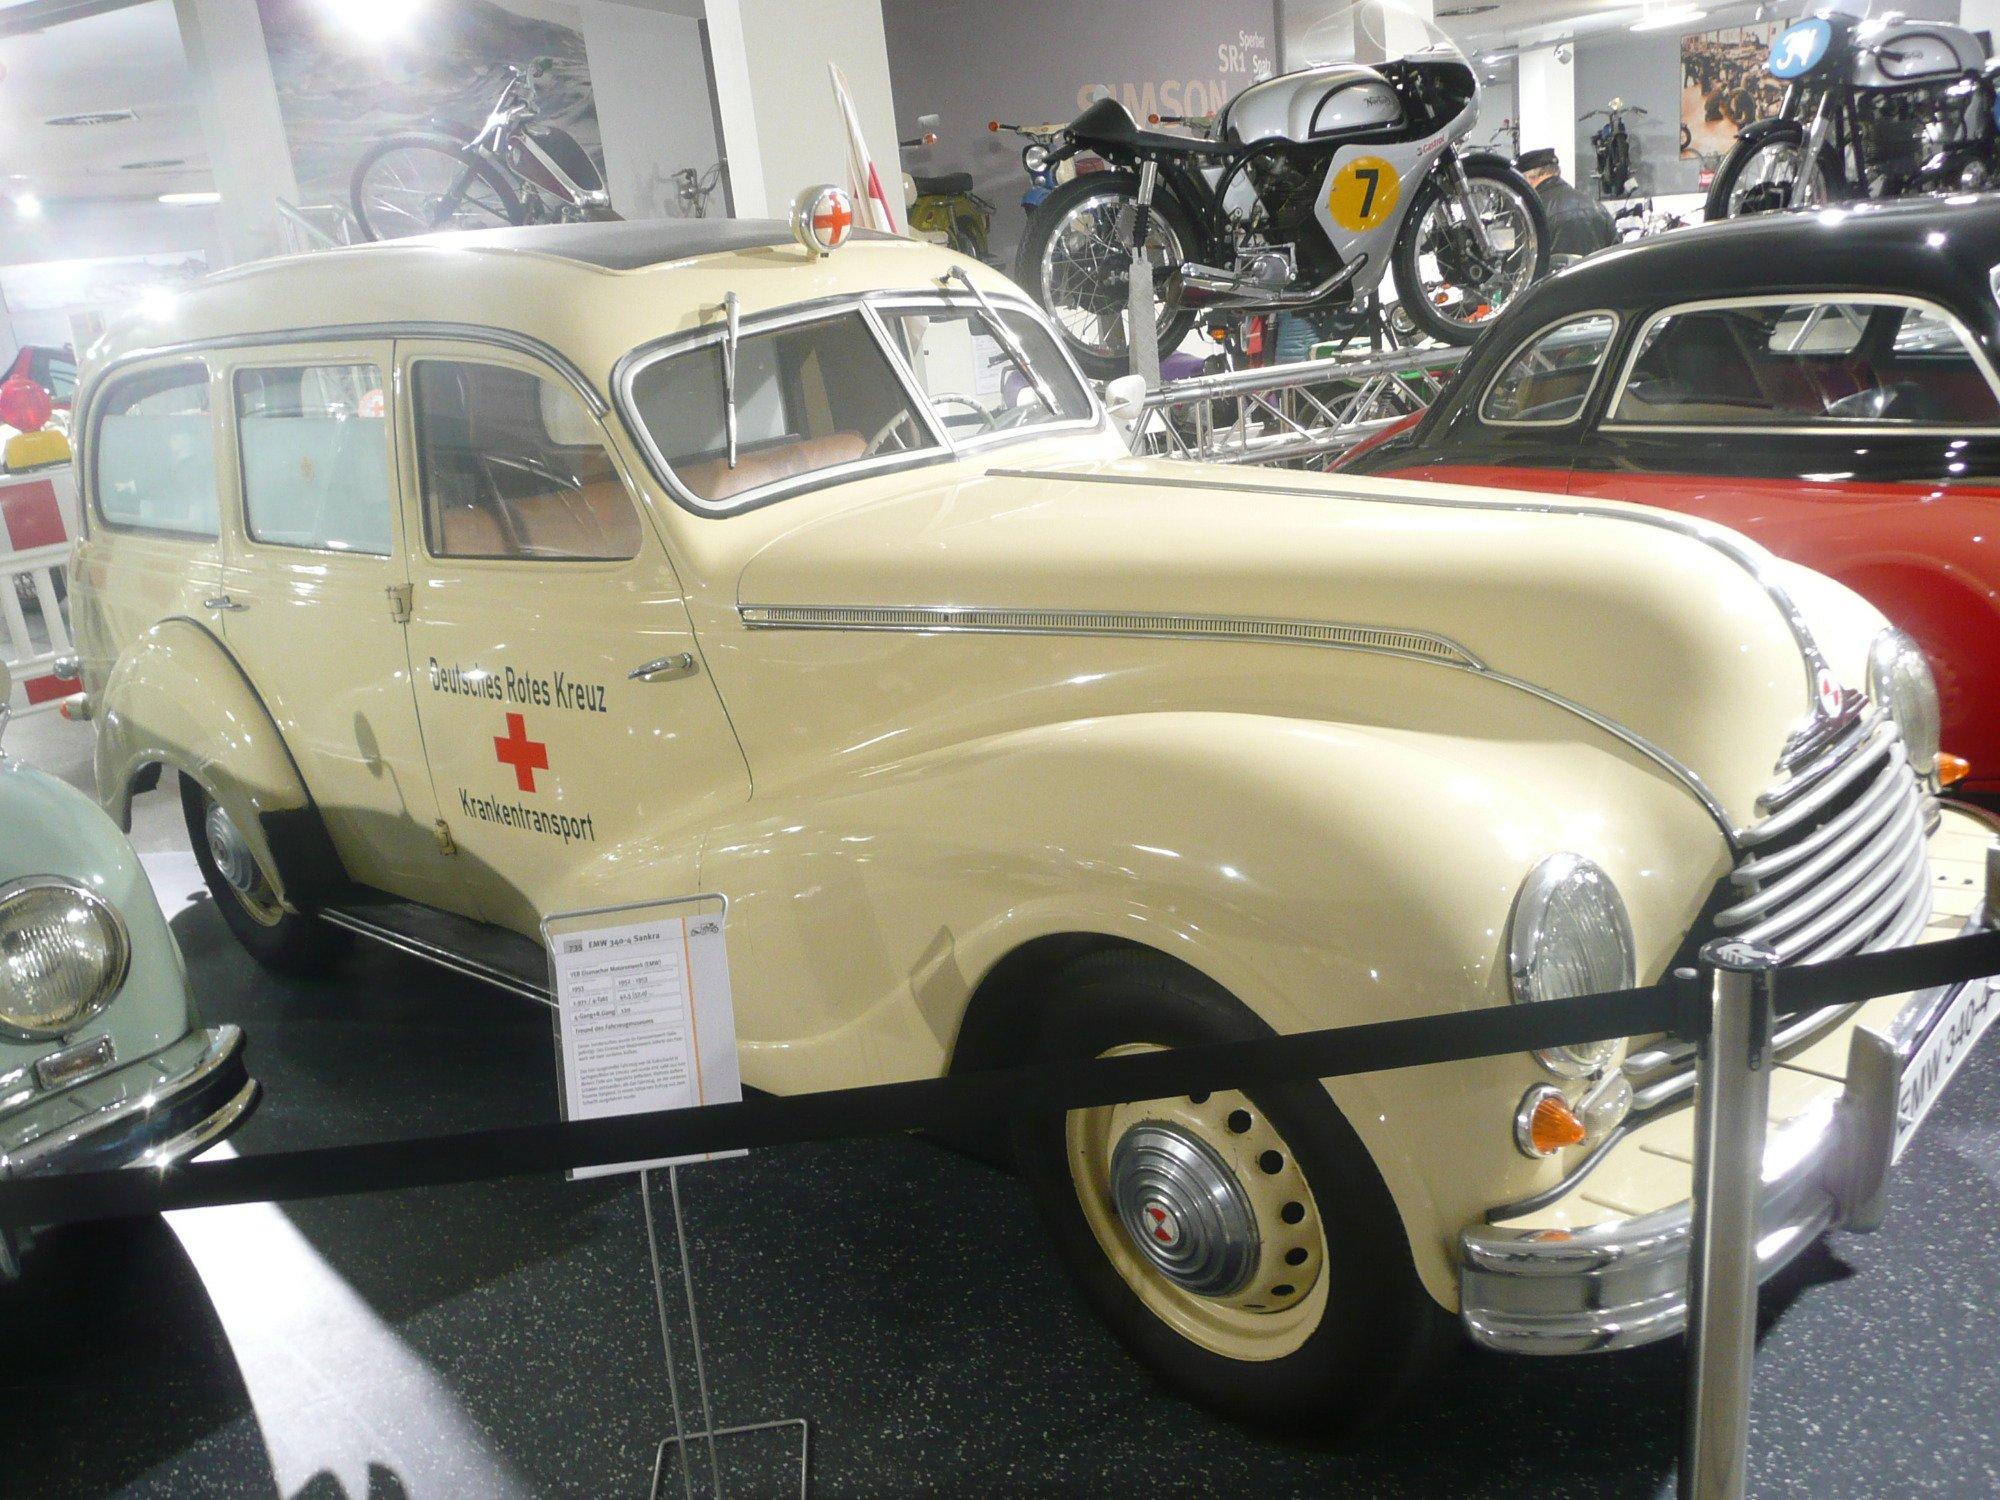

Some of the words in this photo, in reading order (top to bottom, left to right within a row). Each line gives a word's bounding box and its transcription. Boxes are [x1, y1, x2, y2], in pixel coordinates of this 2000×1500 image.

[1218, 43, 1245, 72] SR1
[1356, 169, 1379, 217] 7
[429, 657, 502, 700] Deutsches
[505, 666, 551, 706] Rotes
[554, 671, 607, 713] Kreuz
[459, 787, 595, 845] Krankentransport
[589, 939, 607, 949] EMW
[610, 938, 631, 948] 340-4
[633, 933, 660, 942] Sankra
